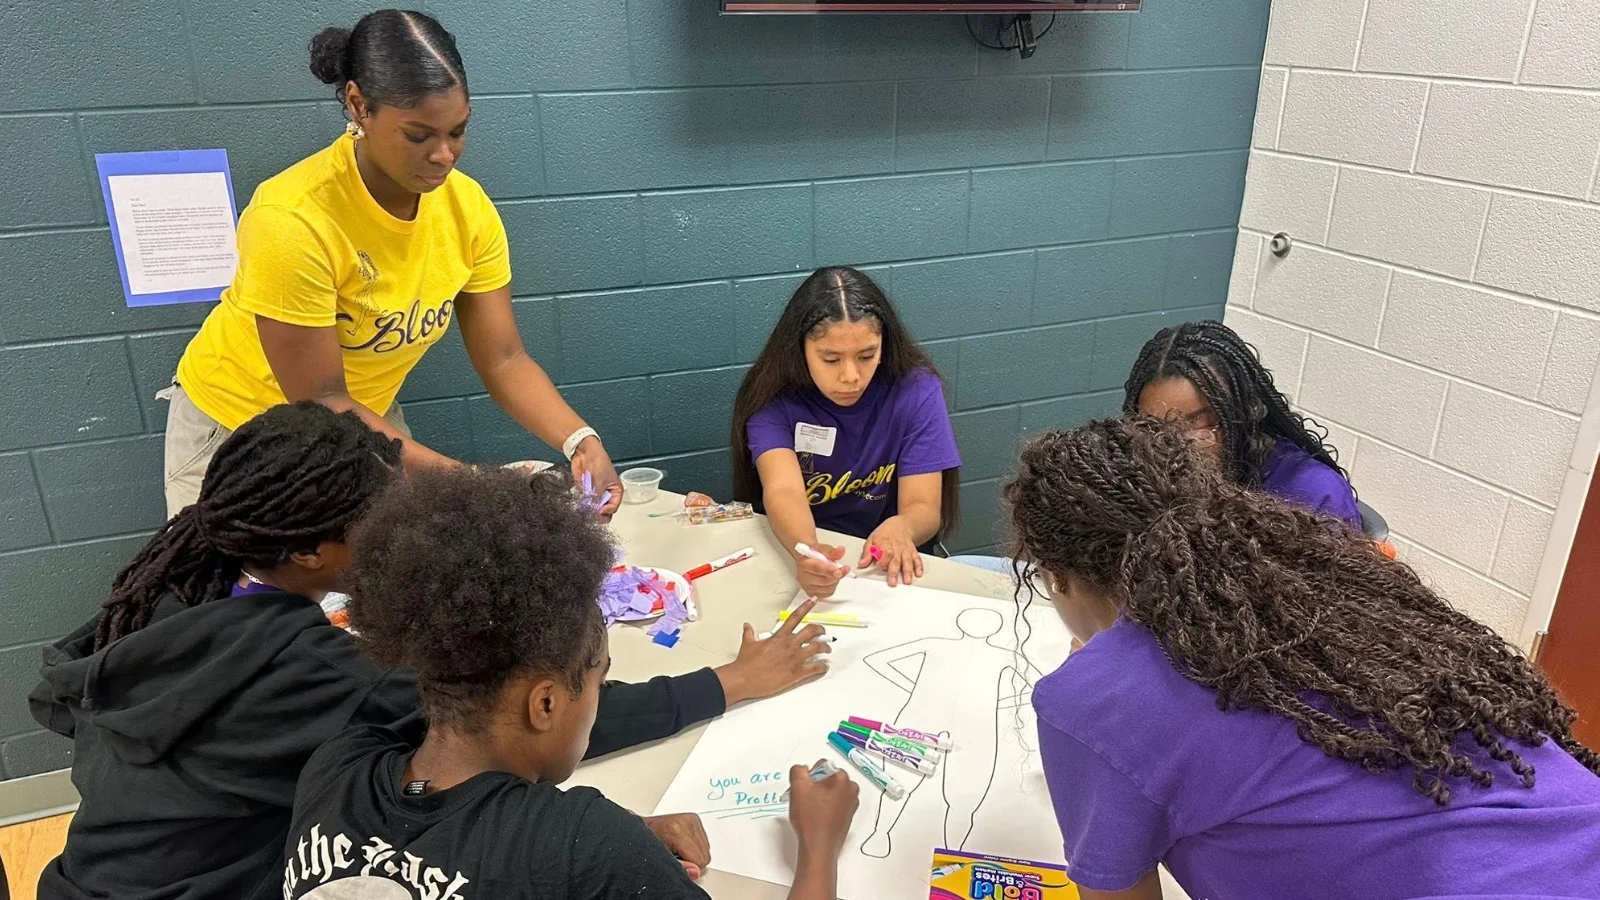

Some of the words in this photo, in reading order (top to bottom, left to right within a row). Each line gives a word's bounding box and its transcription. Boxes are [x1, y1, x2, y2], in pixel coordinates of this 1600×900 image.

[340, 299, 453, 353] Bloo
[806, 463, 896, 506] Bloom
[707, 777, 741, 801] you
[750, 771, 781, 784] are
[297, 823, 355, 883] the
[975, 872, 1015, 885] Brites
